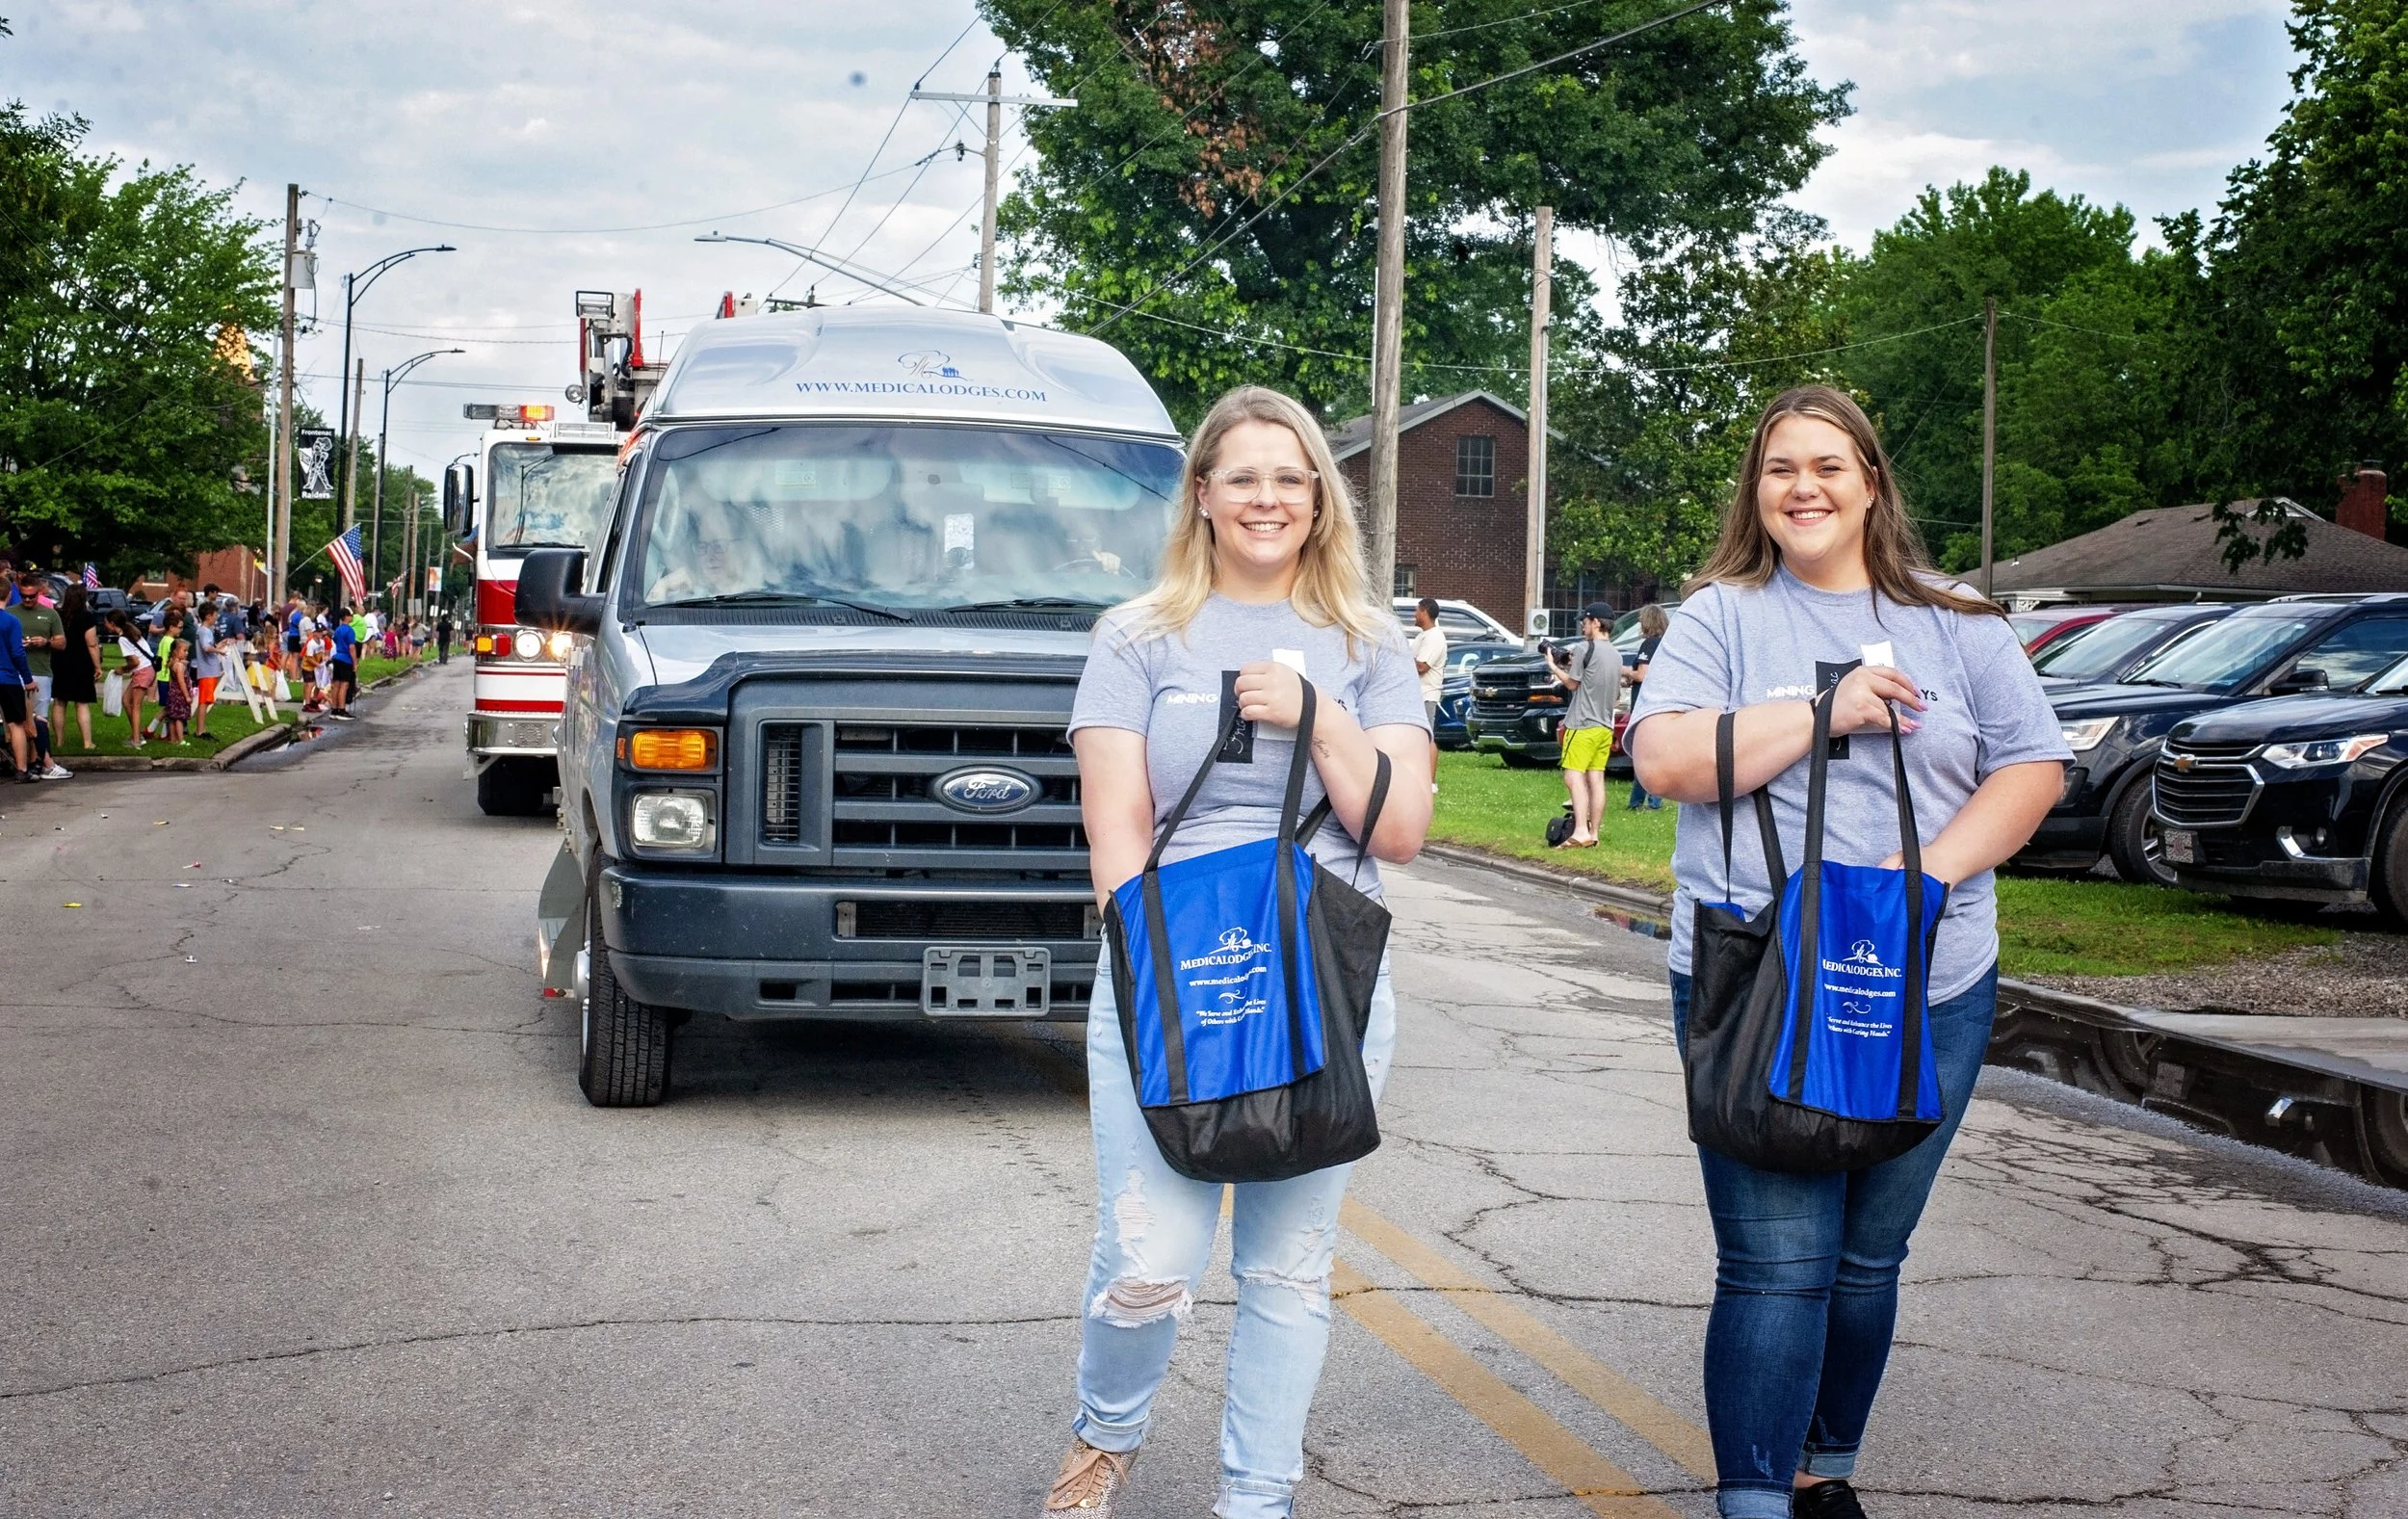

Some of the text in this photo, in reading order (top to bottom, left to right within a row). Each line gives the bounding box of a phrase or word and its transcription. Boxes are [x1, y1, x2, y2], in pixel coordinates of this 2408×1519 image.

[796, 382, 1047, 402] WWW.MEDICALODGES.COM
[1166, 693, 1218, 704] MINING
[1766, 685, 1938, 701] MINING YS
[963, 778, 1011, 799] Ford
